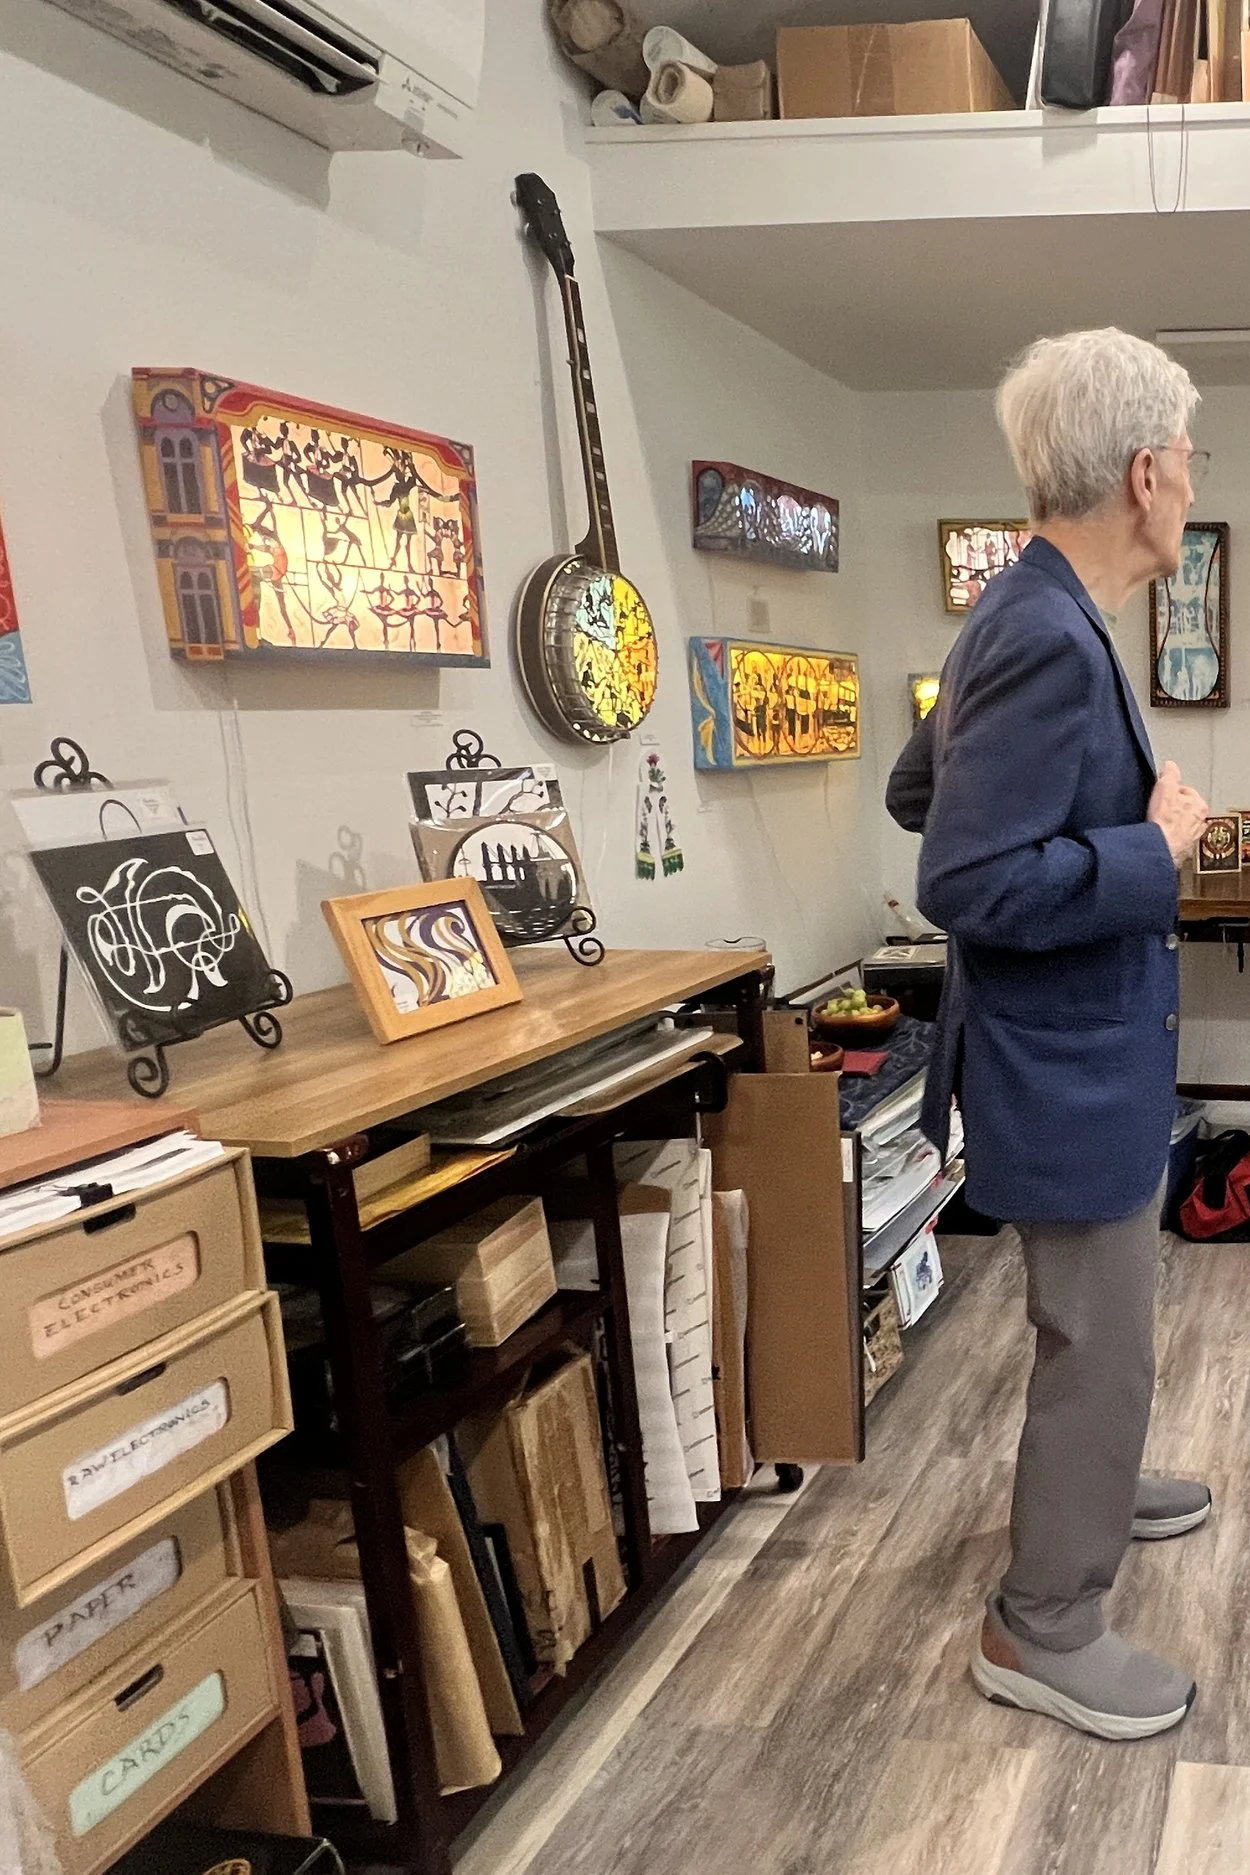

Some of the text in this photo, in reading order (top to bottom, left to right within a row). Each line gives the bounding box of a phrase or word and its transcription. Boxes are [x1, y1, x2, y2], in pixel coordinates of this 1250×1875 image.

[43, 1263, 184, 1338] ELECTRONICS
[58, 1258, 154, 1310] CONSUMER
[110, 1399, 211, 1463] ELECTRONICS
[43, 1573, 136, 1647] PAPER
[102, 1704, 191, 1796] CARDS
